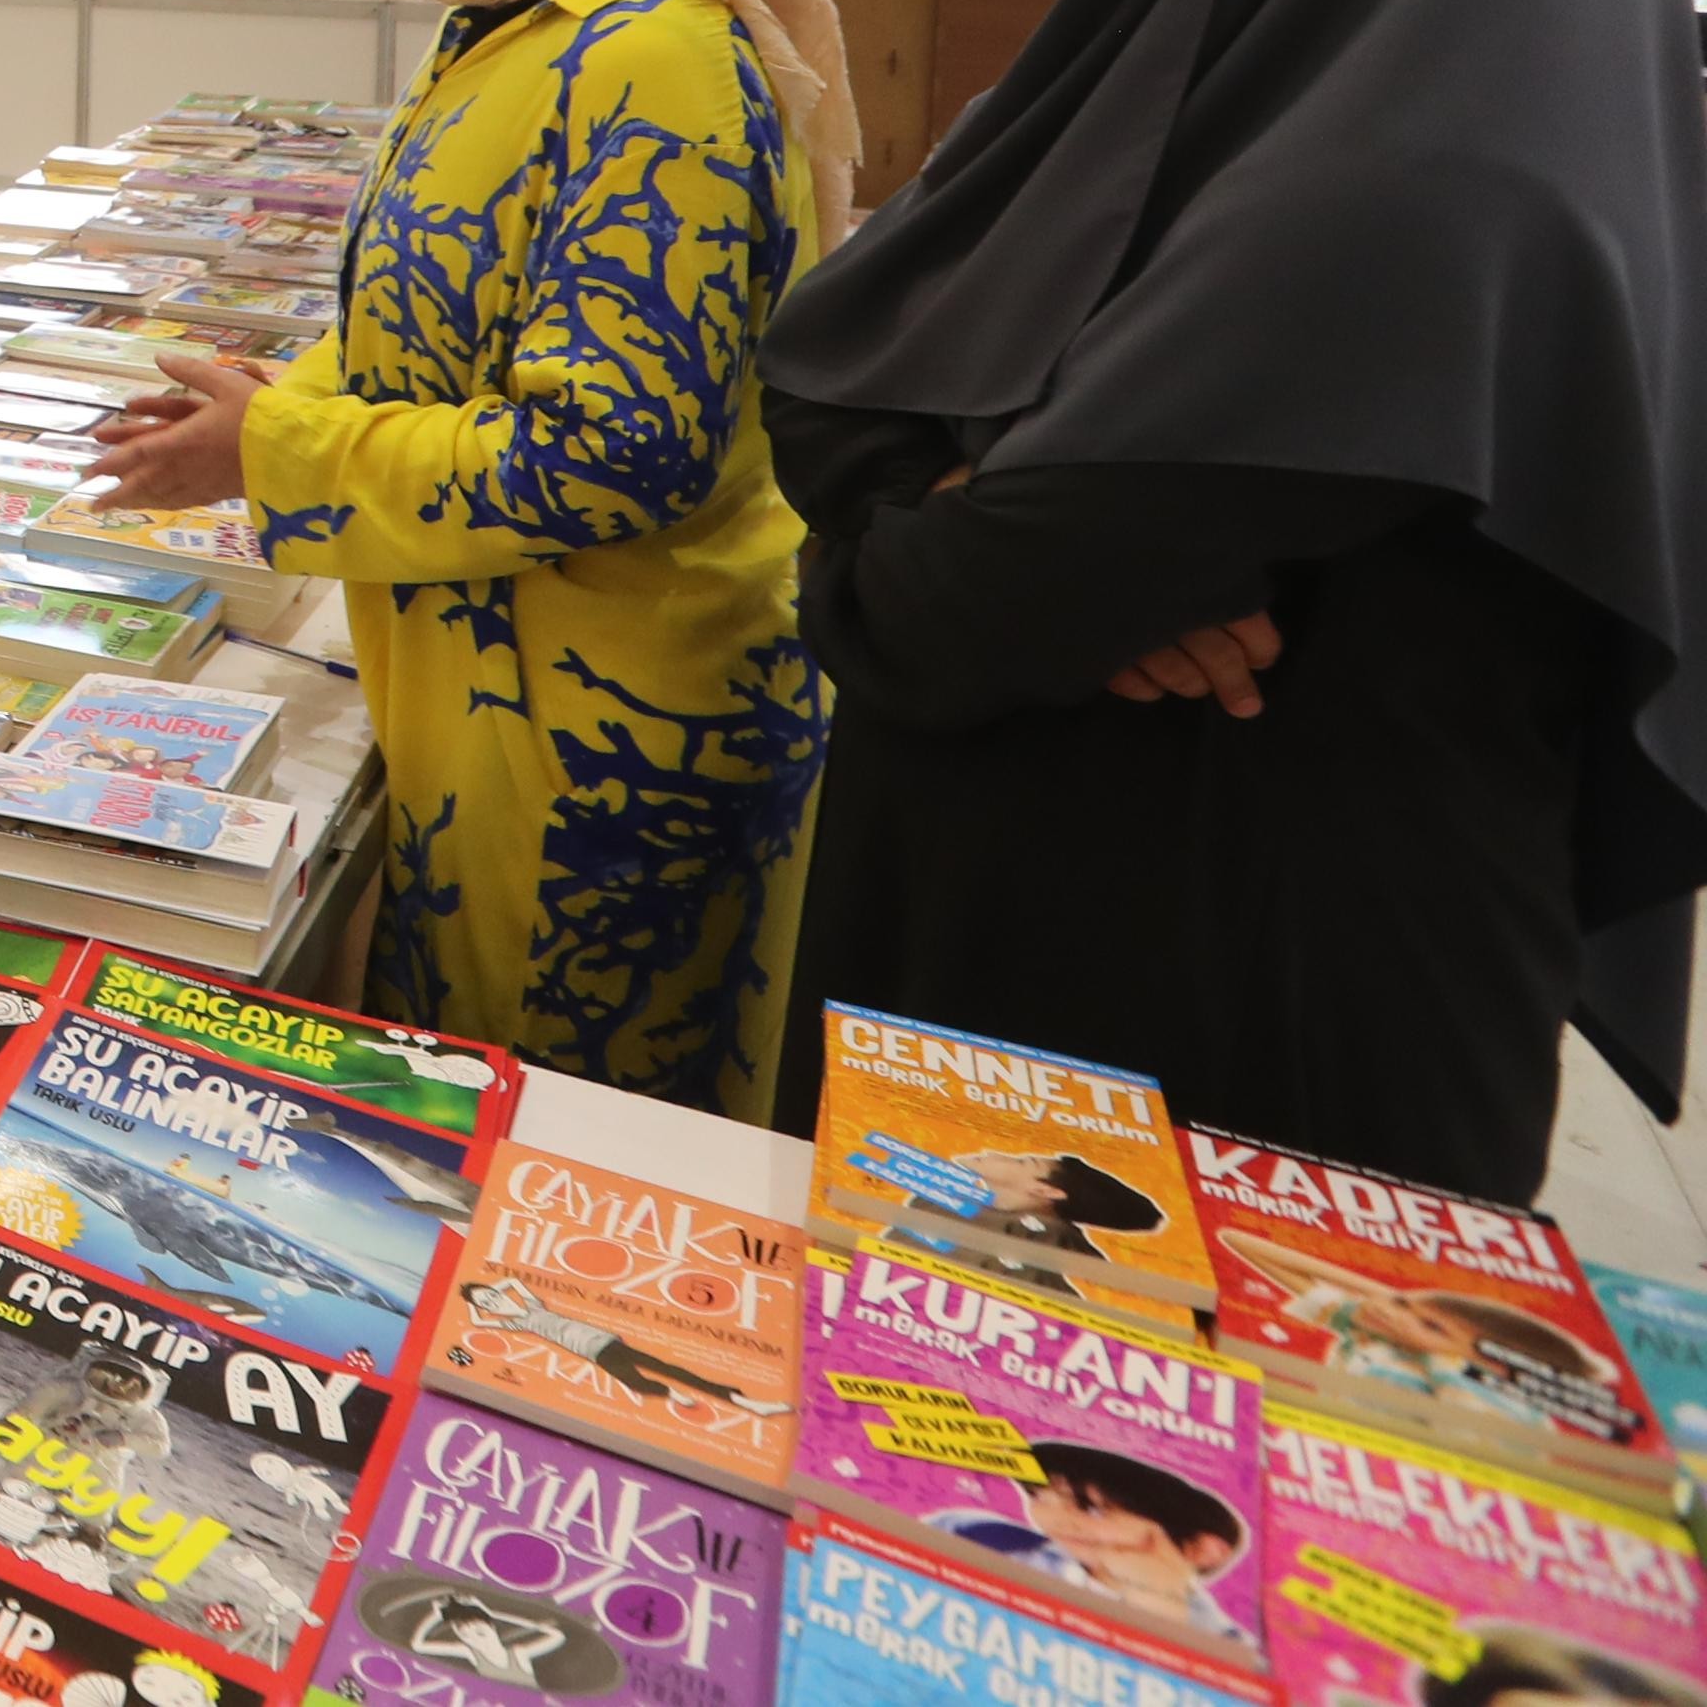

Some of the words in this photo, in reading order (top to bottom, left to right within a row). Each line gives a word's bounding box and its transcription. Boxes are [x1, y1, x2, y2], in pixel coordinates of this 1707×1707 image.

[95, 986, 338, 1071] SALYANGOZLAR
[176, 989, 344, 1047] ACAYİP
[33, 1083, 83, 1113] TARIK
[89, 1107, 136, 1133] USLU
[38, 1054, 299, 1170] BALİNALAR
[129, 1053, 308, 1131] ACAYİP
[8, 1272, 211, 1369] ACAYİP
[226, 1350, 361, 1443] AY
